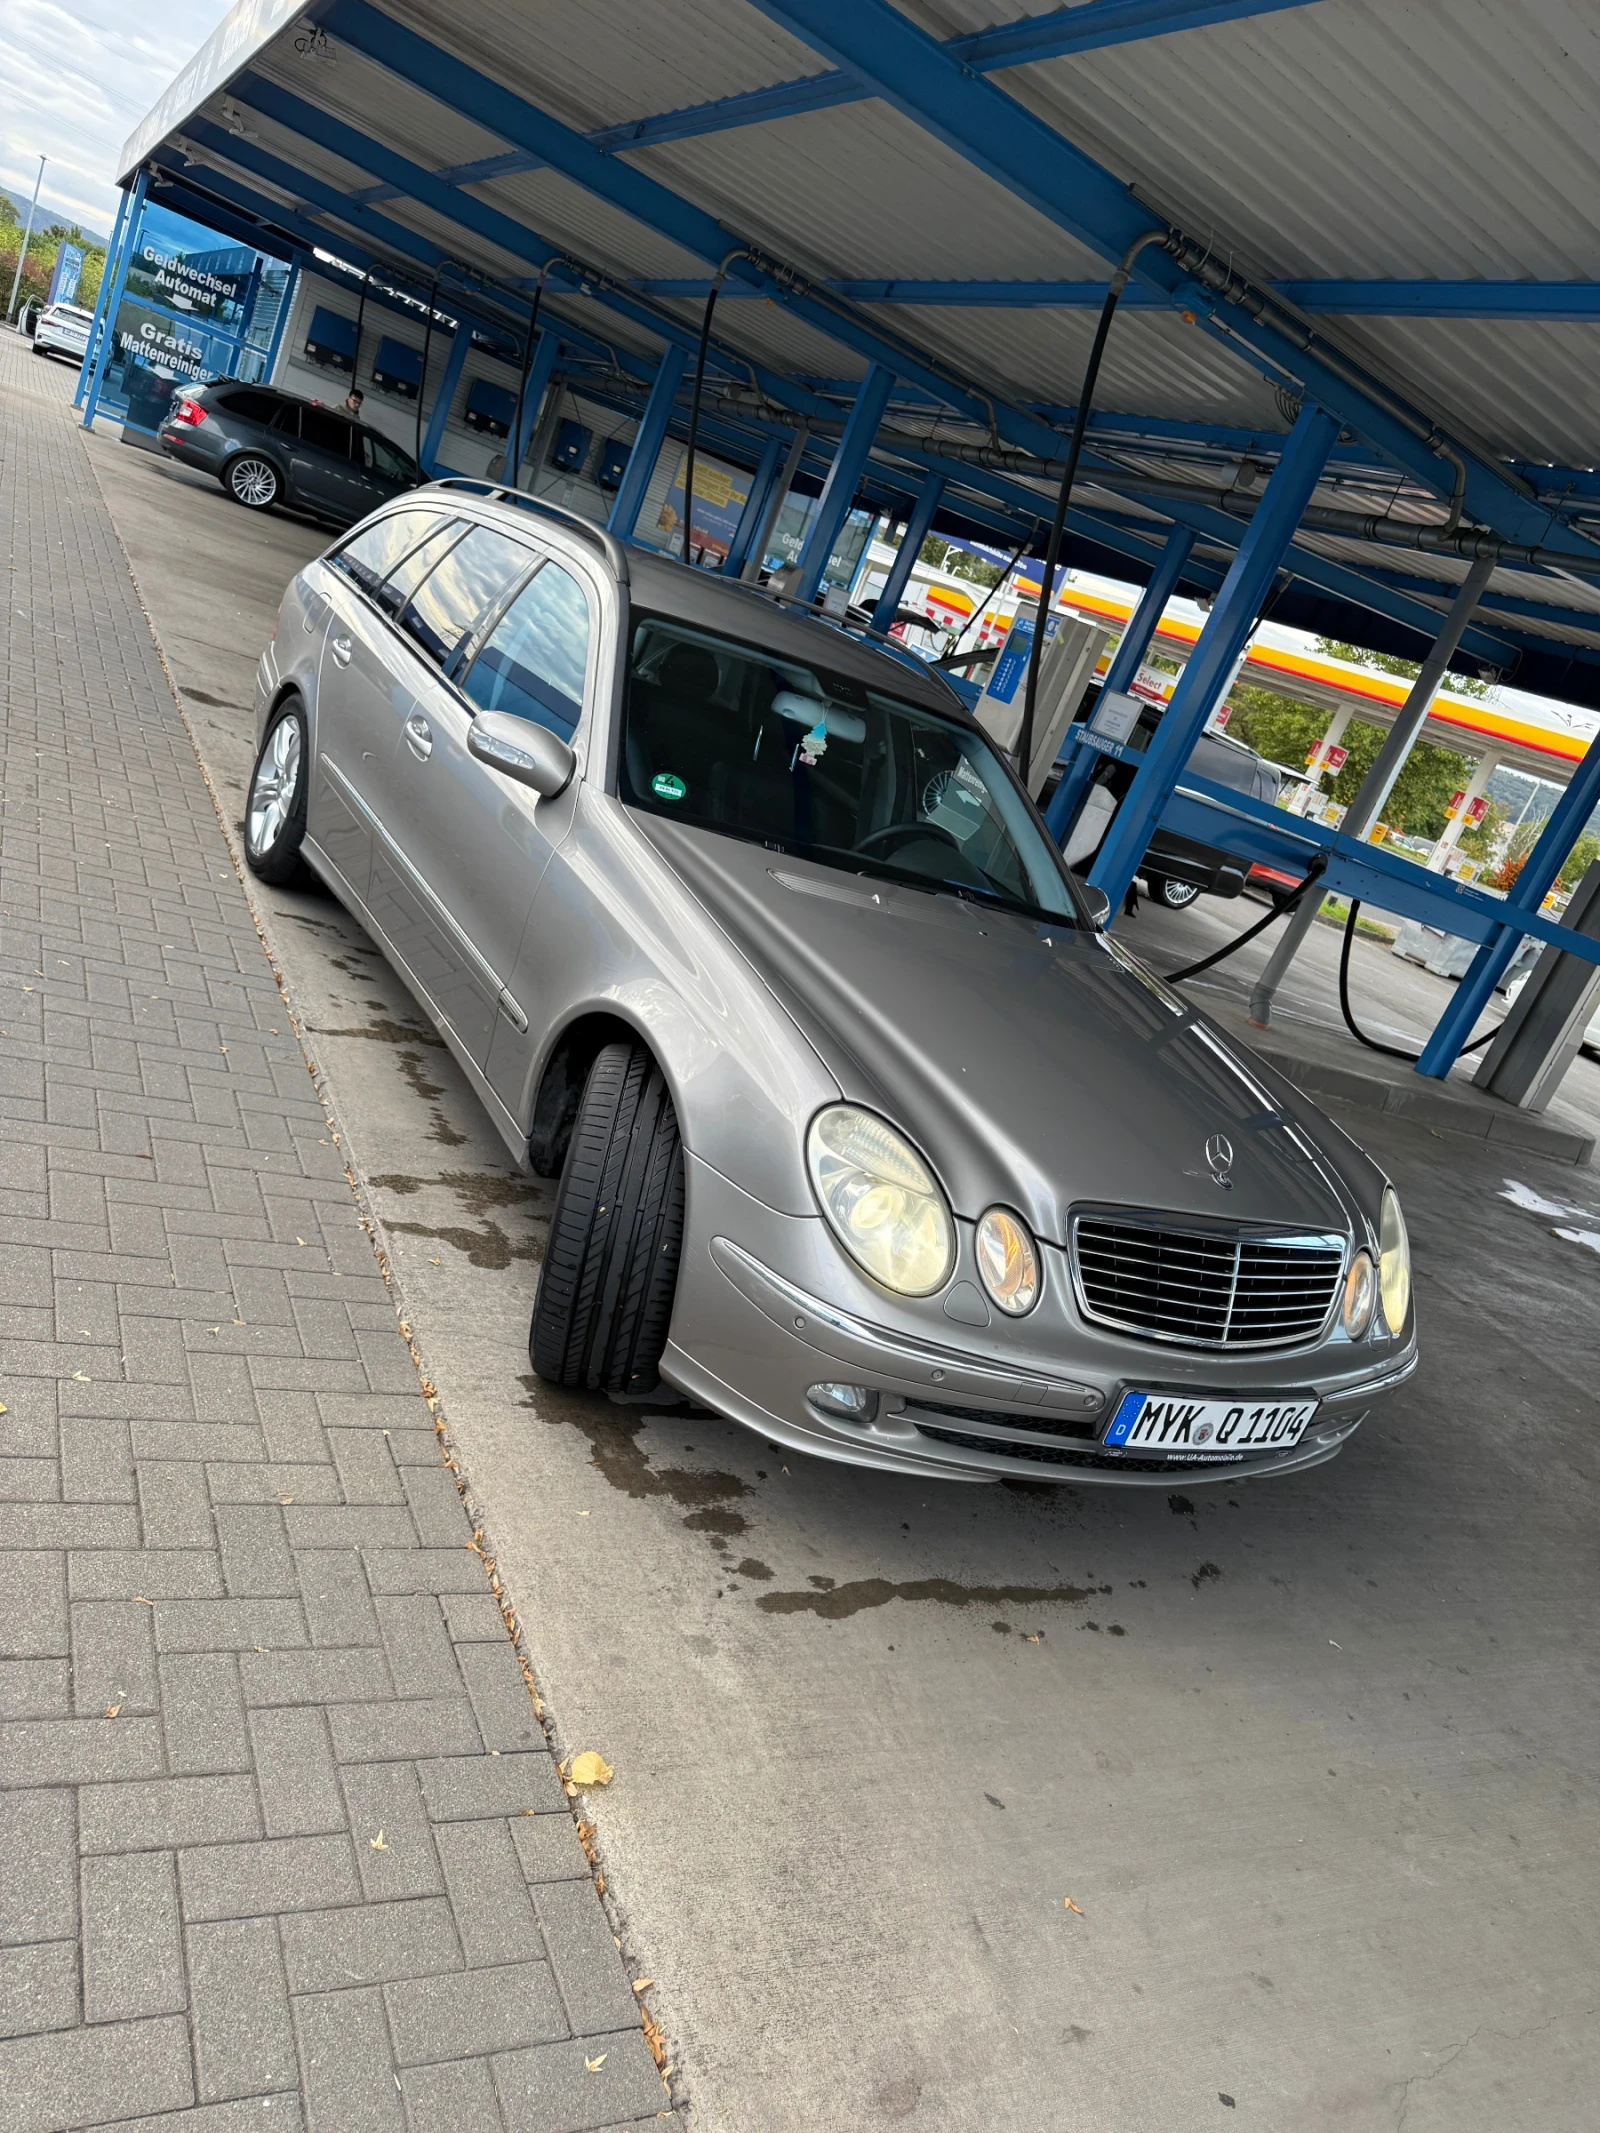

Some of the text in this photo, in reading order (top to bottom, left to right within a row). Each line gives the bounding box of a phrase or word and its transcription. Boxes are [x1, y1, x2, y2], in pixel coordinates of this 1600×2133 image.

[143, 245, 238, 298] Geldwechsel
[154, 269, 217, 307] Automat
[120, 331, 214, 381] Mattenreiniger
[140, 322, 203, 360] Gratis
[1137, 672, 1161, 690] Select
[1075, 729, 1115, 754] STAUBSAUGER
[665, 776, 675, 787] 4
[1115, 1424, 1126, 1435] D
[1131, 1401, 1309, 1444] MYK Q 1104
